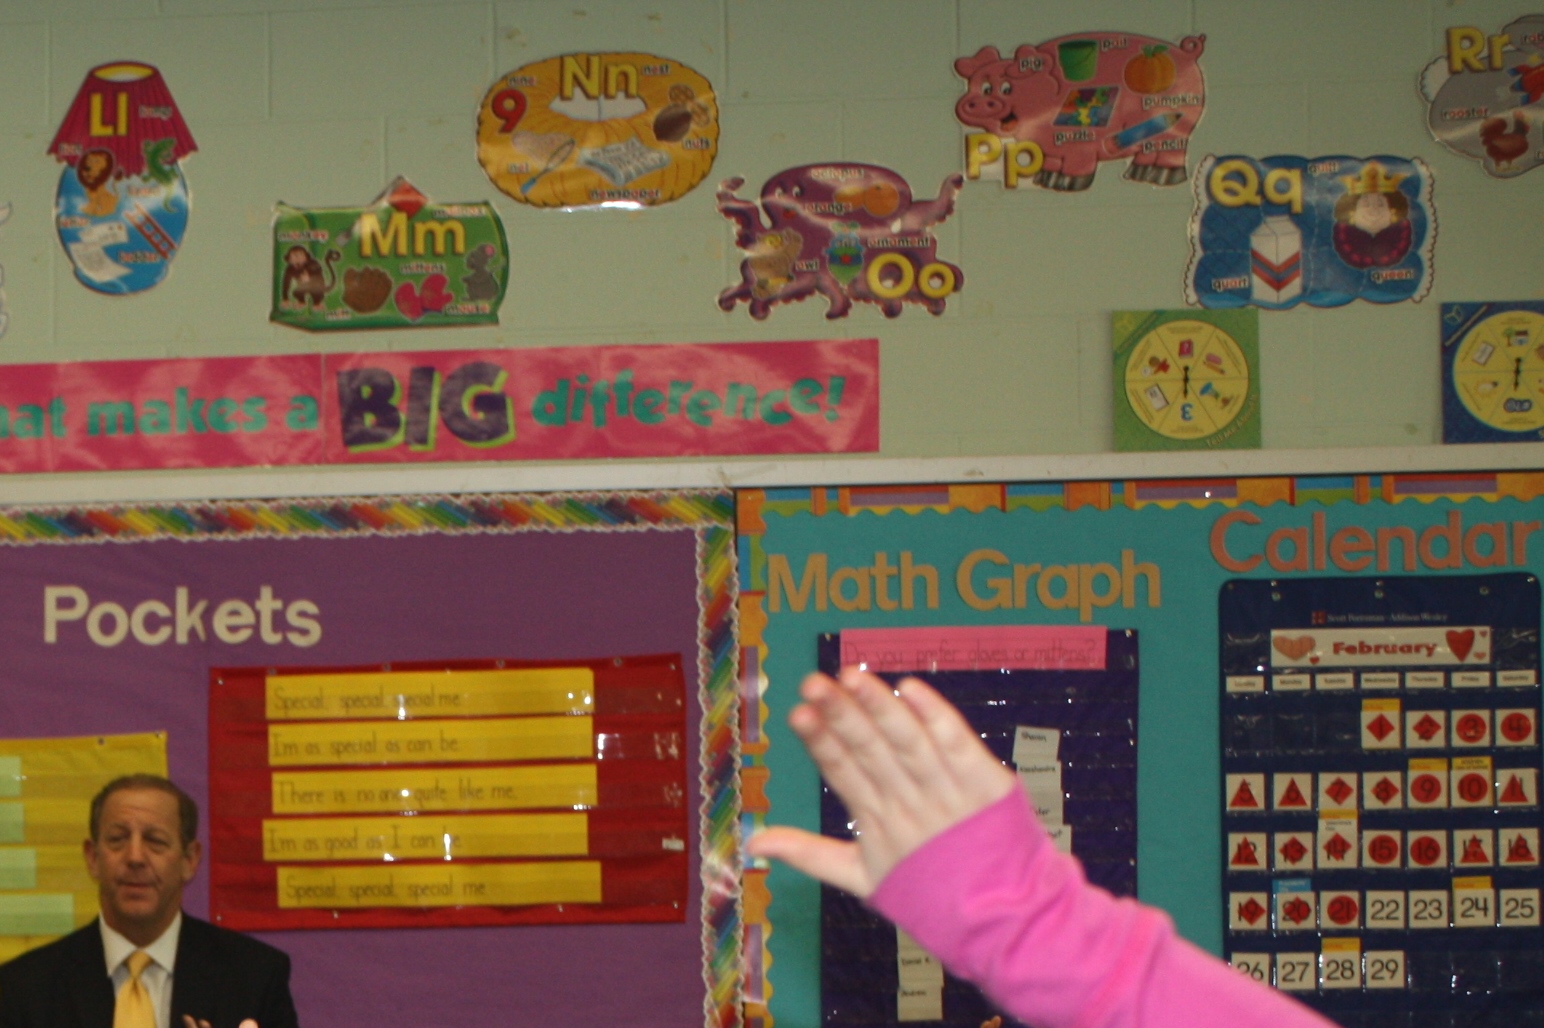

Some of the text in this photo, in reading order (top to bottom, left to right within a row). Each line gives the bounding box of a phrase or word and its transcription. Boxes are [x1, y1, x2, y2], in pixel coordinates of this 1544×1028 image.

[1447, 26, 1511, 73] Rr
[644, 64, 669, 75] nest
[1021, 57, 1042, 71] pig
[560, 56, 639, 100] Nn
[492, 89, 526, 133] 9
[1143, 94, 1198, 109] pumpkin
[90, 91, 128, 136] Ll
[1443, 107, 1489, 118] rooster
[685, 138, 710, 149] nuts
[1056, 130, 1095, 142] puzzle
[965, 132, 1044, 189] Pp
[812, 168, 863, 181] octopus
[591, 188, 660, 199] newspaper
[1209, 159, 1303, 213] Qq
[807, 202, 852, 215] orange
[359, 212, 465, 257] Mm
[867, 237, 929, 247] ornament
[795, 260, 818, 271] owl
[866, 252, 955, 299] Oo
[1213, 277, 1248, 291] quart
[1372, 270, 1413, 283] queen
[85, 387, 268, 437] makes
[284, 395, 320, 431] a
[335, 359, 517, 455] BIG
[530, 367, 846, 431] difference!
[1210, 509, 1541, 572] Calendar
[767, 548, 1161, 623] Math Graph
[43, 585, 322, 647] Pockets
[876, 650, 902, 671] you
[916, 639, 954, 670] prefer
[969, 639, 1005, 669] gloves
[1033, 638, 1097, 664] mittens?
[1332, 639, 1438, 658] February
[1509, 718, 1523, 737] 4
[305, 739, 320, 753] as
[330, 731, 376, 759] special
[386, 738, 401, 751] as
[407, 738, 433, 751] can
[279, 779, 326, 804] There
[334, 779, 347, 800] is
[414, 780, 447, 807] quite
[458, 777, 484, 800] like
[1376, 779, 1390, 800] 8
[1421, 778, 1434, 799] 9
[303, 838, 320, 852] as
[325, 829, 358, 855] good
[366, 836, 383, 850] as
[410, 835, 434, 849] can
[1373, 842, 1393, 860] 15
[1416, 842, 1435, 859] 16
[1238, 902, 1257, 921] 19
[1284, 901, 1310, 920] 20
[1332, 901, 1351, 919] 21
[1371, 901, 1399, 920] 22
[1413, 900, 1443, 920] 23
[1459, 898, 1488, 918] 24
[1505, 898, 1535, 918] 25
[1281, 962, 1310, 982] 27
[1326, 960, 1354, 980] 28
[1371, 960, 1398, 980] 29
